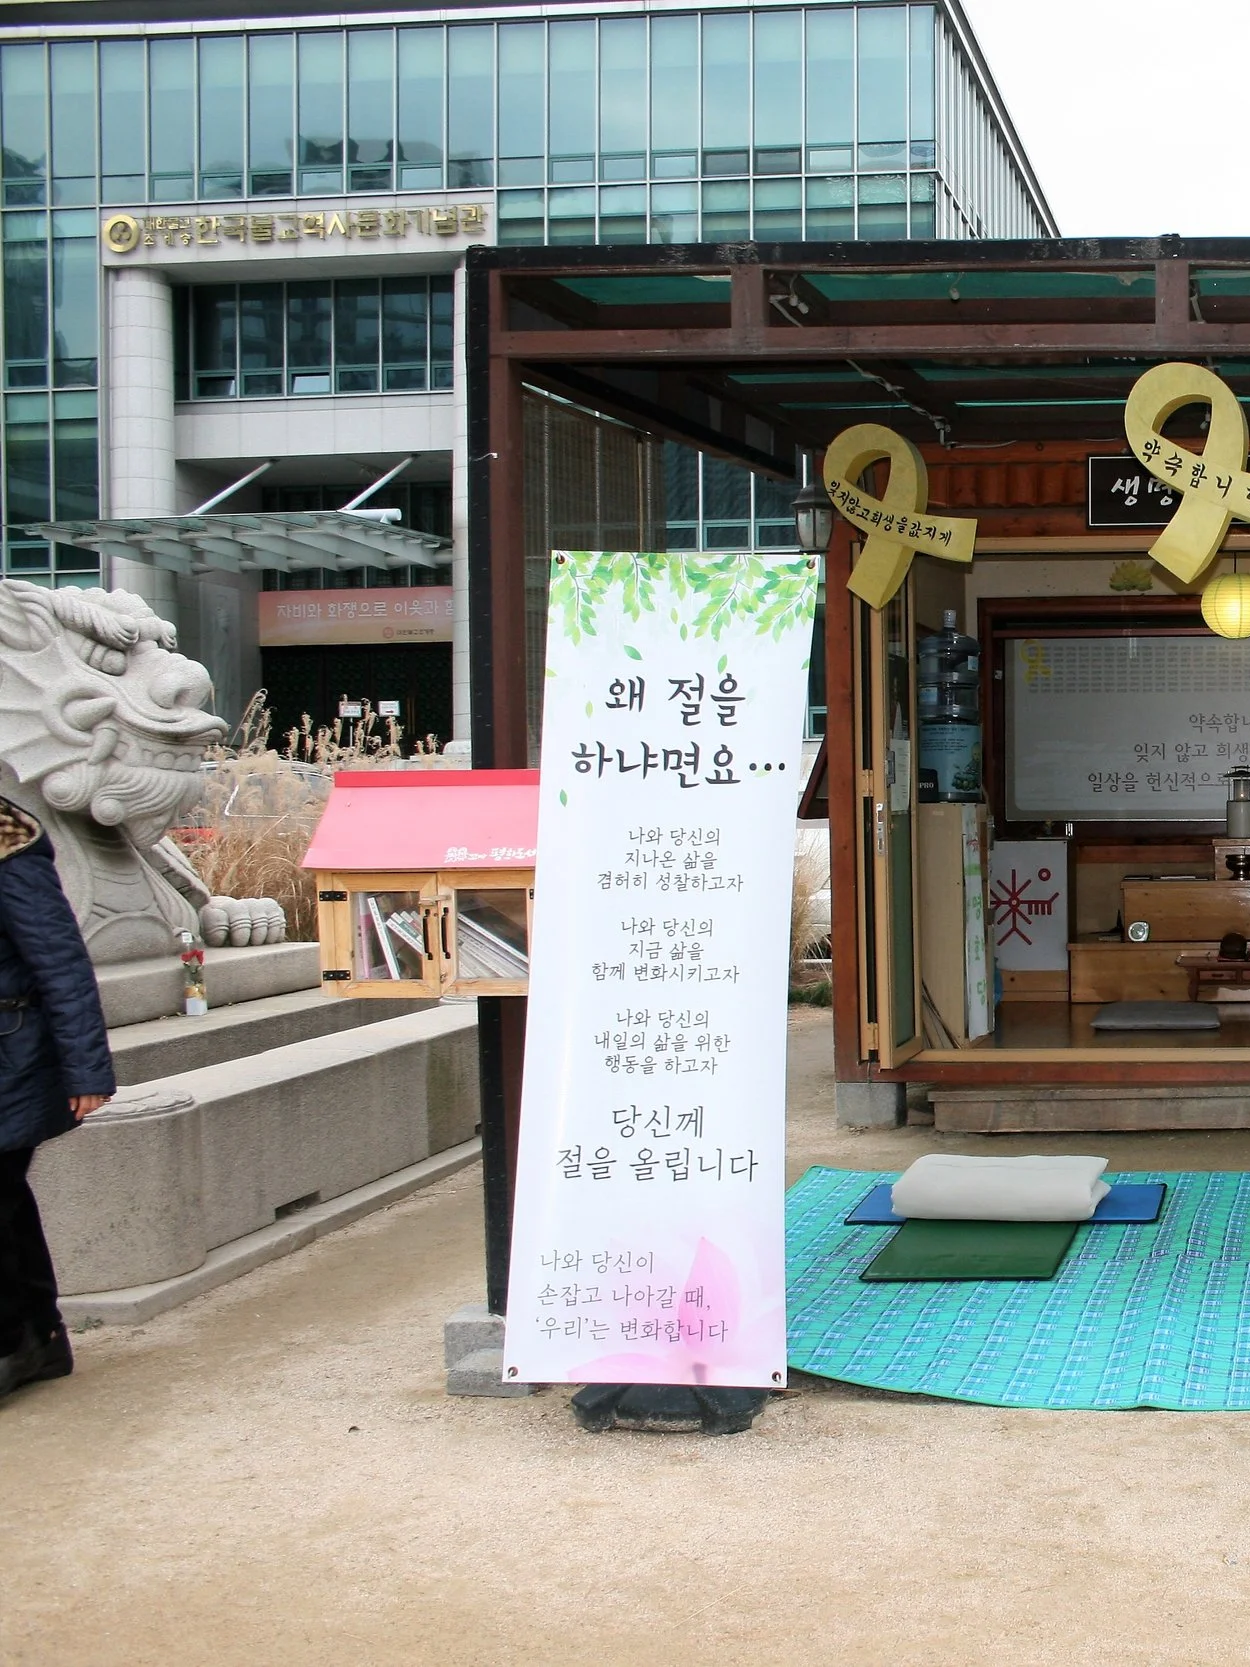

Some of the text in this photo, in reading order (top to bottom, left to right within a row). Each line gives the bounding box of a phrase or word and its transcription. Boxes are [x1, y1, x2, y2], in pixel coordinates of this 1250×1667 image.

[144, 215, 193, 231] 대한불교
[195, 205, 485, 245] 한국불교역사문화기념관
[277, 603, 321, 619] 자비와
[327, 602, 388, 618] 화쟁으로
[394, 600, 439, 616] 이웃과
[605, 673, 746, 726] 왜 절을
[1134, 743, 1166, 763] 잊지
[1174, 743, 1209, 763] 않고
[1087, 772, 1138, 793] 일상을
[629, 827, 720, 846] 나와 당신의
[625, 849, 718, 870] 지나온 삶을
[597, 871, 744, 892] 겸허히 성찰하고자
[621, 917, 713, 937] 나와 당신의
[629, 940, 704, 961] 지금 삶을
[592, 962, 740, 984] 함께 변화시키고자
[616, 1009, 709, 1029] 나와 당신의
[594, 1031, 731, 1053] 내일의 삶을 위한
[605, 1054, 718, 1075] 행동을 하고자
[612, 1105, 704, 1138] 당신께
[556, 1145, 758, 1182] 절을 올립니다
[541, 1250, 654, 1274] 나와 당신이
[537, 1283, 711, 1310] 손잡고 나아갈 때,
[620, 1318, 728, 1343] 변화합니다
